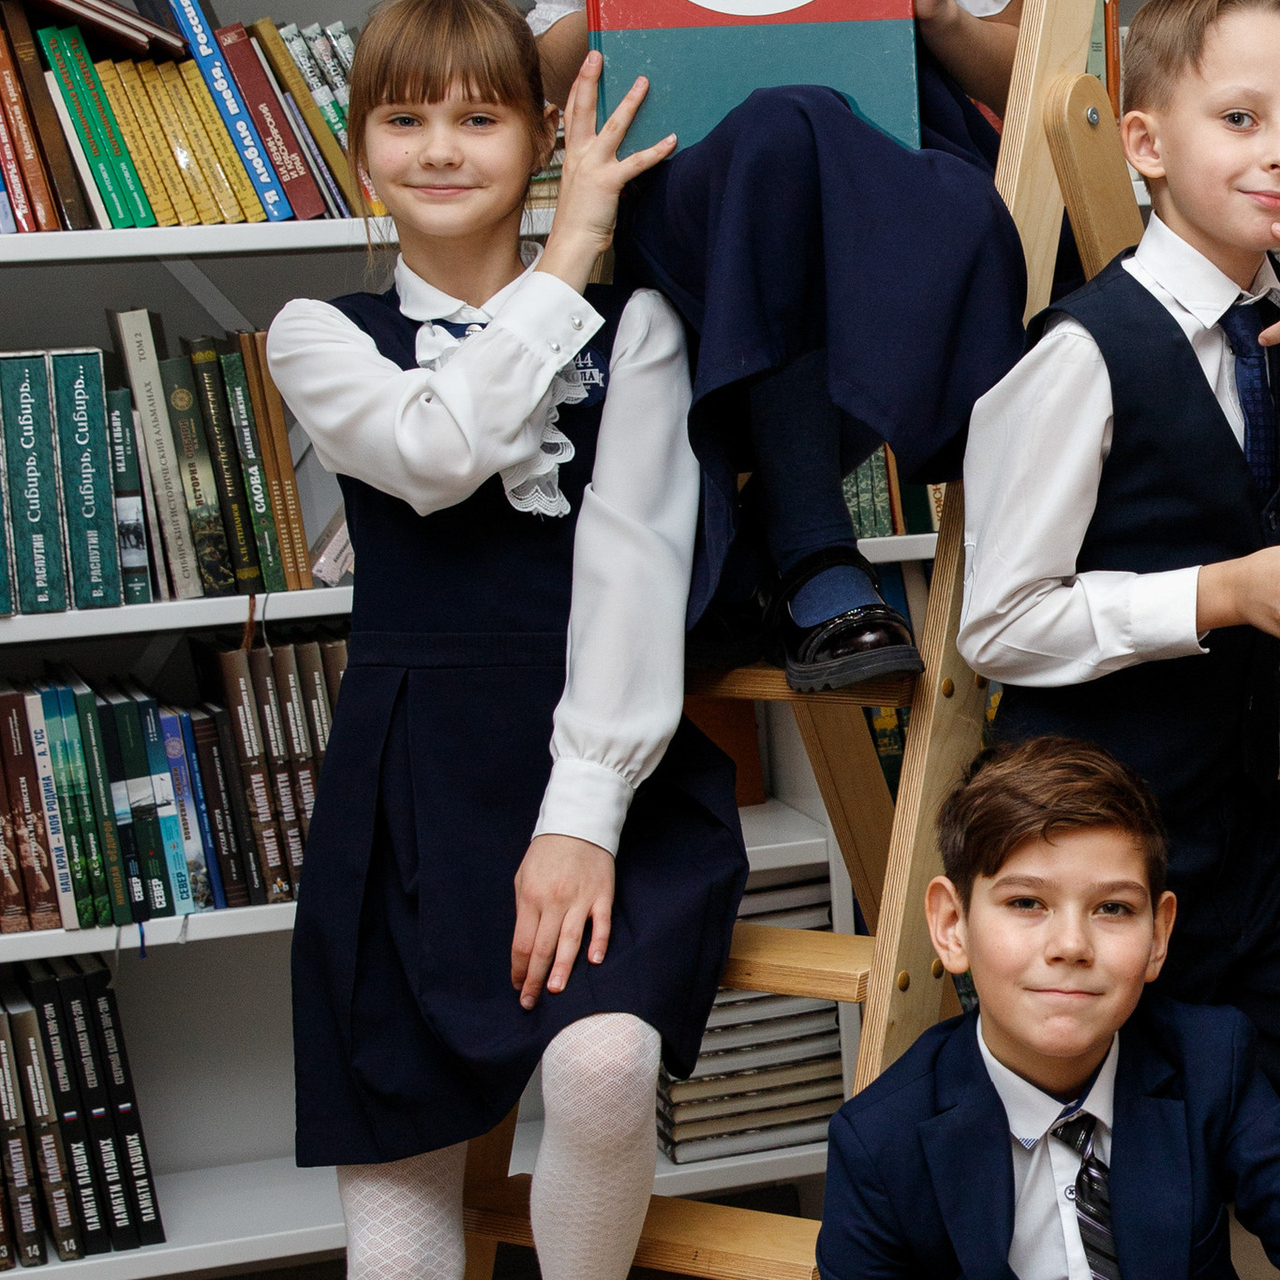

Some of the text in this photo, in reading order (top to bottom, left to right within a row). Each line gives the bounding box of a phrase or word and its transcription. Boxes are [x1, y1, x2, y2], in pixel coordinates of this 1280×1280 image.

[205, 59, 241, 117] тебя,
[231, 118, 271, 186] люблю
[263, 188, 279, 204] Я
[135, 338, 146, 361] ТОМ
[142, 380, 162, 436] АЛЬМАНАХ
[110, 410, 126, 471] БЕЛАЯ СИБИРЬ
[15, 368, 48, 601] В. РАСПУТИН Сибирь, Сибирь...
[154, 438, 178, 518] ИСТОРИЧЕСКИЙ
[170, 519, 191, 579] СИБИРСКИЙ
[33, 728, 46, 746] УСС
[41, 775, 59, 811] РОДИНА
[48, 813, 61, 834] МОЯ
[51, 845, 67, 870] КРАЙ
[58, 872, 71, 893] НАШ
[151, 877, 166, 908] СЕВЕР
[40, 1133, 71, 1227] КНИГА ПАМЯТИ
[125, 1132, 155, 1222] ПАМЯТИ ПАВШИХ
[62, 1240, 76, 1252] 14
